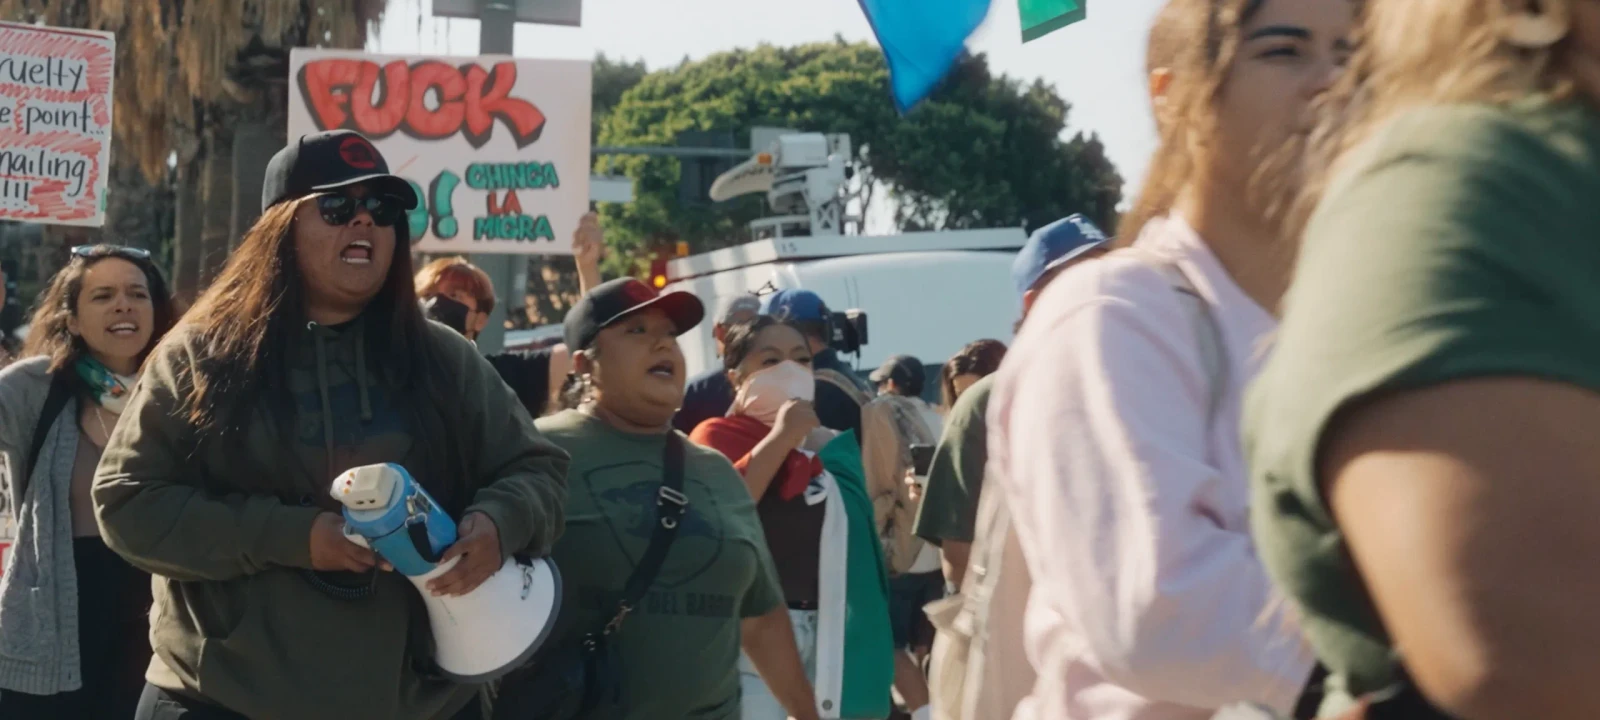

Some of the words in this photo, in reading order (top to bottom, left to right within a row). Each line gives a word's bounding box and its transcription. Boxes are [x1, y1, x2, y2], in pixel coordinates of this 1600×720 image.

[297, 59, 546, 150] FUCK
[487, 189, 522, 215] LA
[473, 214, 555, 241] MIGRA
